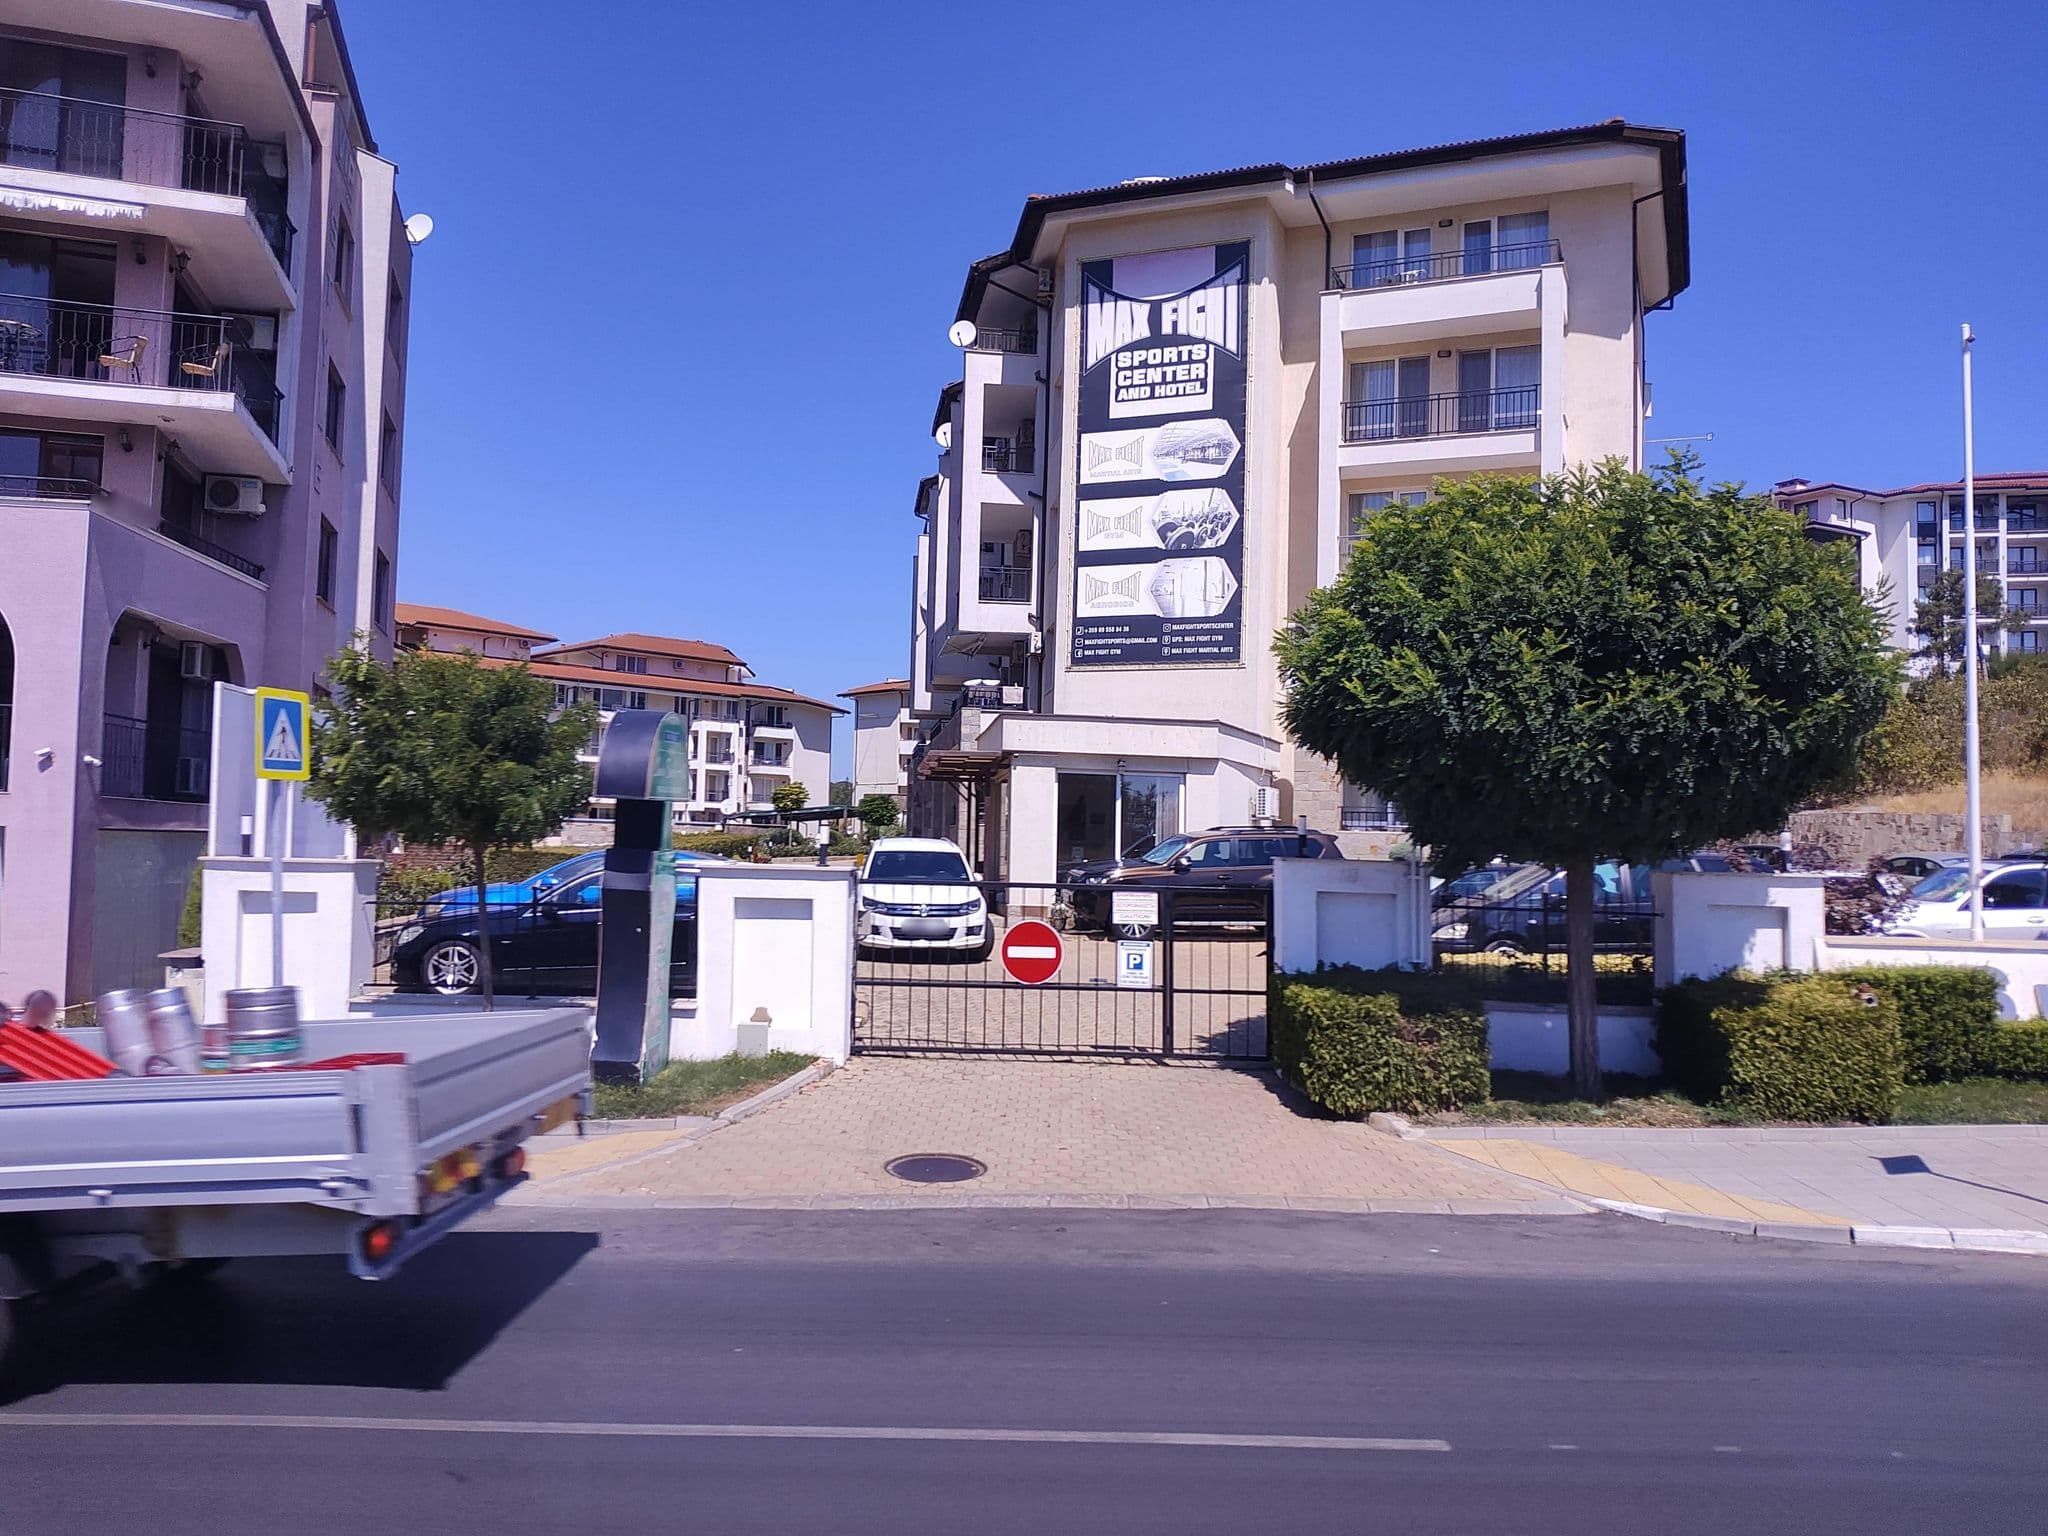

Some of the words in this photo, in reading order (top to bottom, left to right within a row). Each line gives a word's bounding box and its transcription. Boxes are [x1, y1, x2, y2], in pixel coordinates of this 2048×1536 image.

[1087, 281, 1151, 370] MAX
[1161, 263, 1242, 355] FIGHT
[1117, 343, 1207, 368] SPORTS
[1117, 363, 1206, 387] CENTER
[1117, 385, 1154, 402] AND
[1154, 380, 1205, 398] HOTEL
[1088, 439, 1112, 471] MAX
[1086, 508, 1111, 541] MAX
[1085, 573, 1109, 605] MAX
[1128, 953, 1142, 970] P
